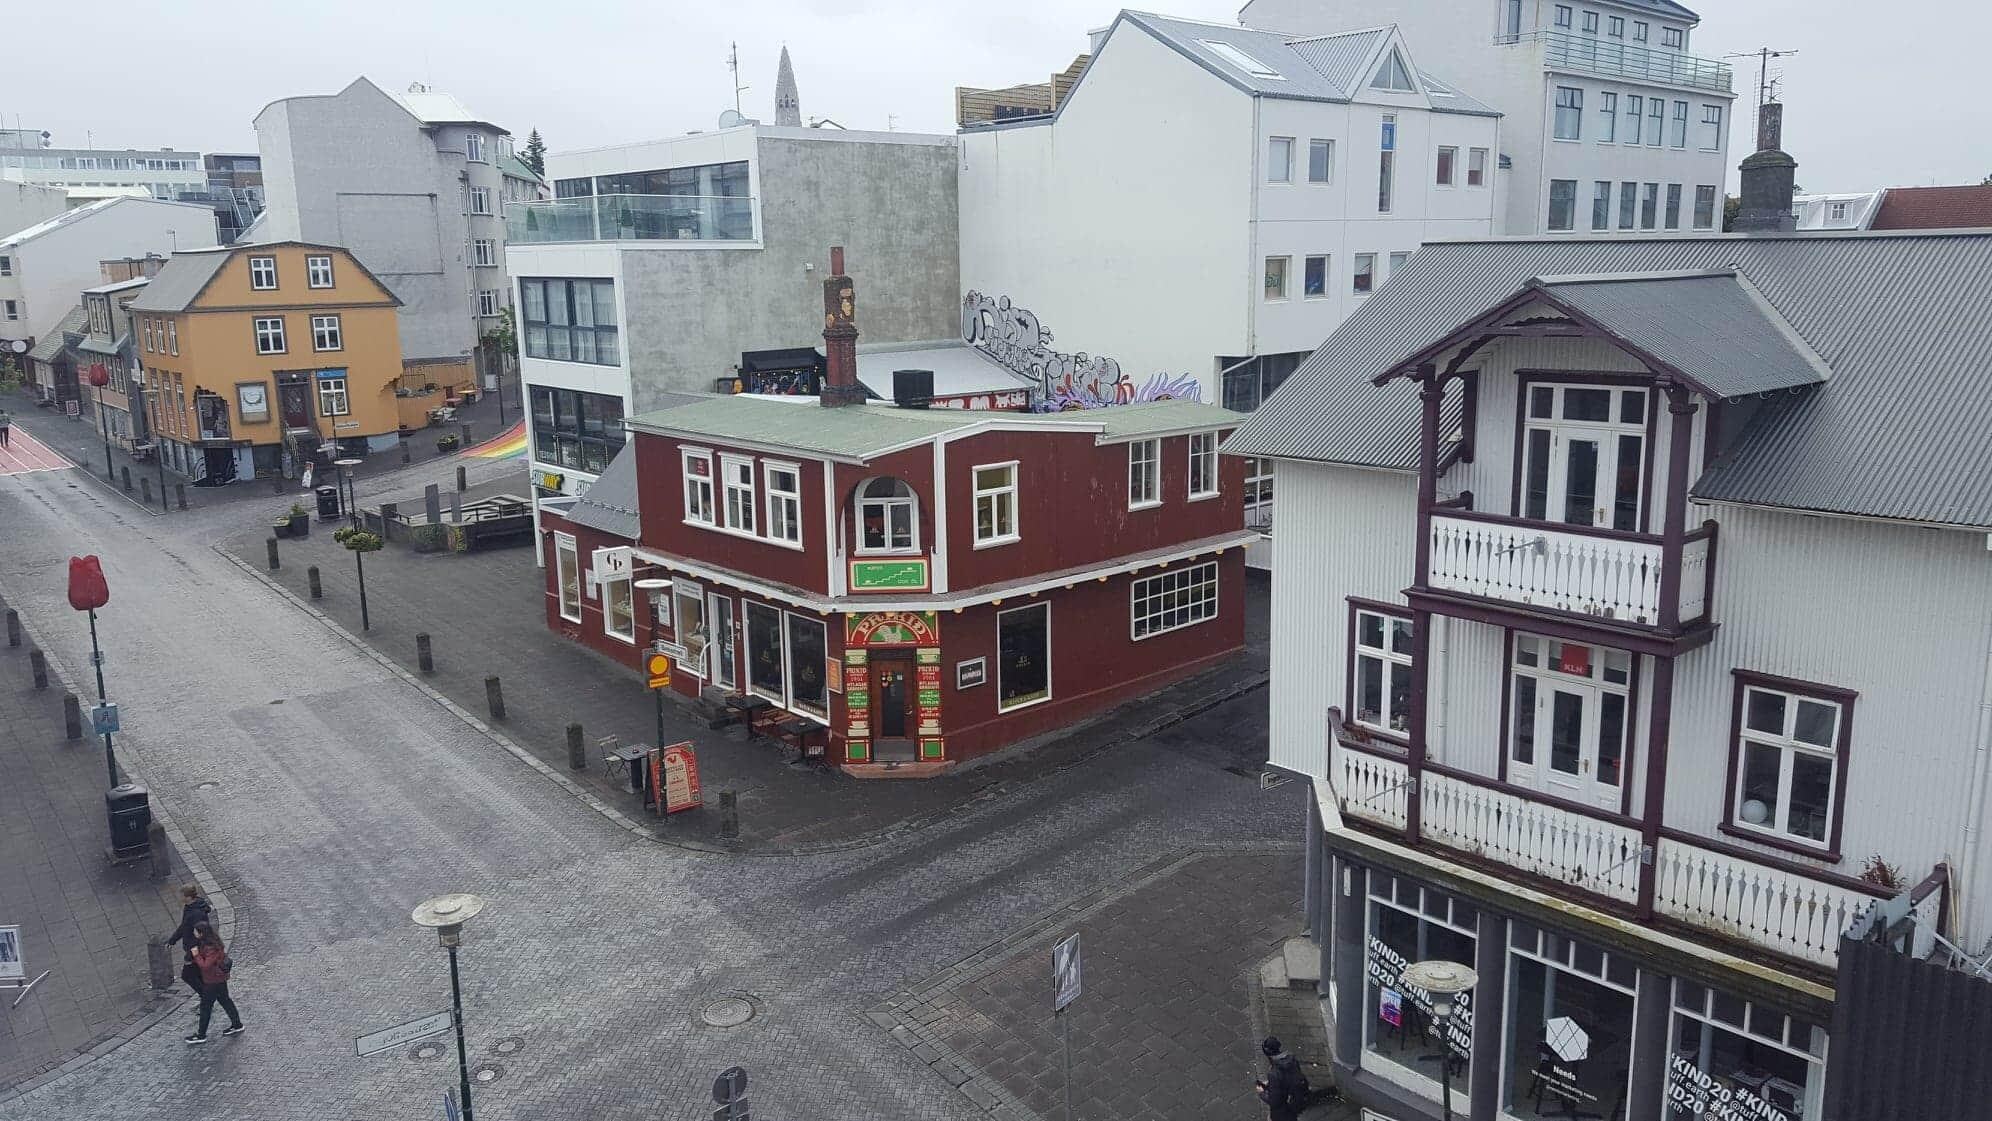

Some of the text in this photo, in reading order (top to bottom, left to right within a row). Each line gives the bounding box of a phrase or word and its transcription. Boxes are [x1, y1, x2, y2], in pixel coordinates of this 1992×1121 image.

[533, 471, 561, 490] SUBWAY
[1369, 935, 1410, 972] KIND2
[1553, 1065, 1577, 1081] Needs
[1671, 1053, 1732, 1103] KIND20
